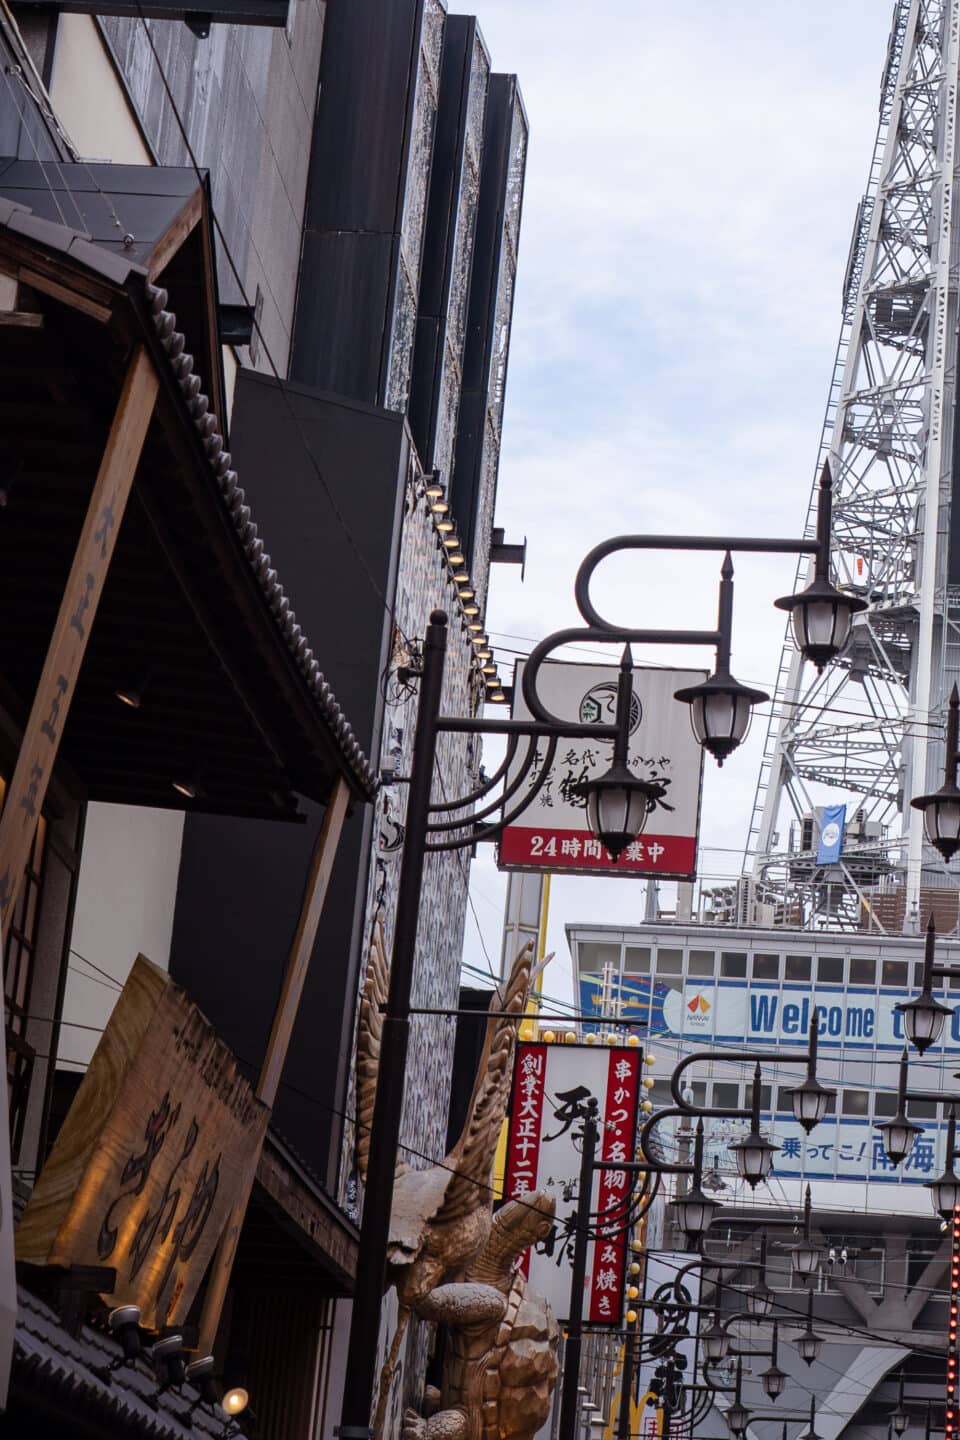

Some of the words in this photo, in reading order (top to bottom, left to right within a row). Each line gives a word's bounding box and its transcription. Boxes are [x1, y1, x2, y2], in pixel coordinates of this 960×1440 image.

[559, 765, 676, 813] 鶴家
[530, 835, 665, 864] 24時間業中
[750, 993, 875, 1039] Welcome
